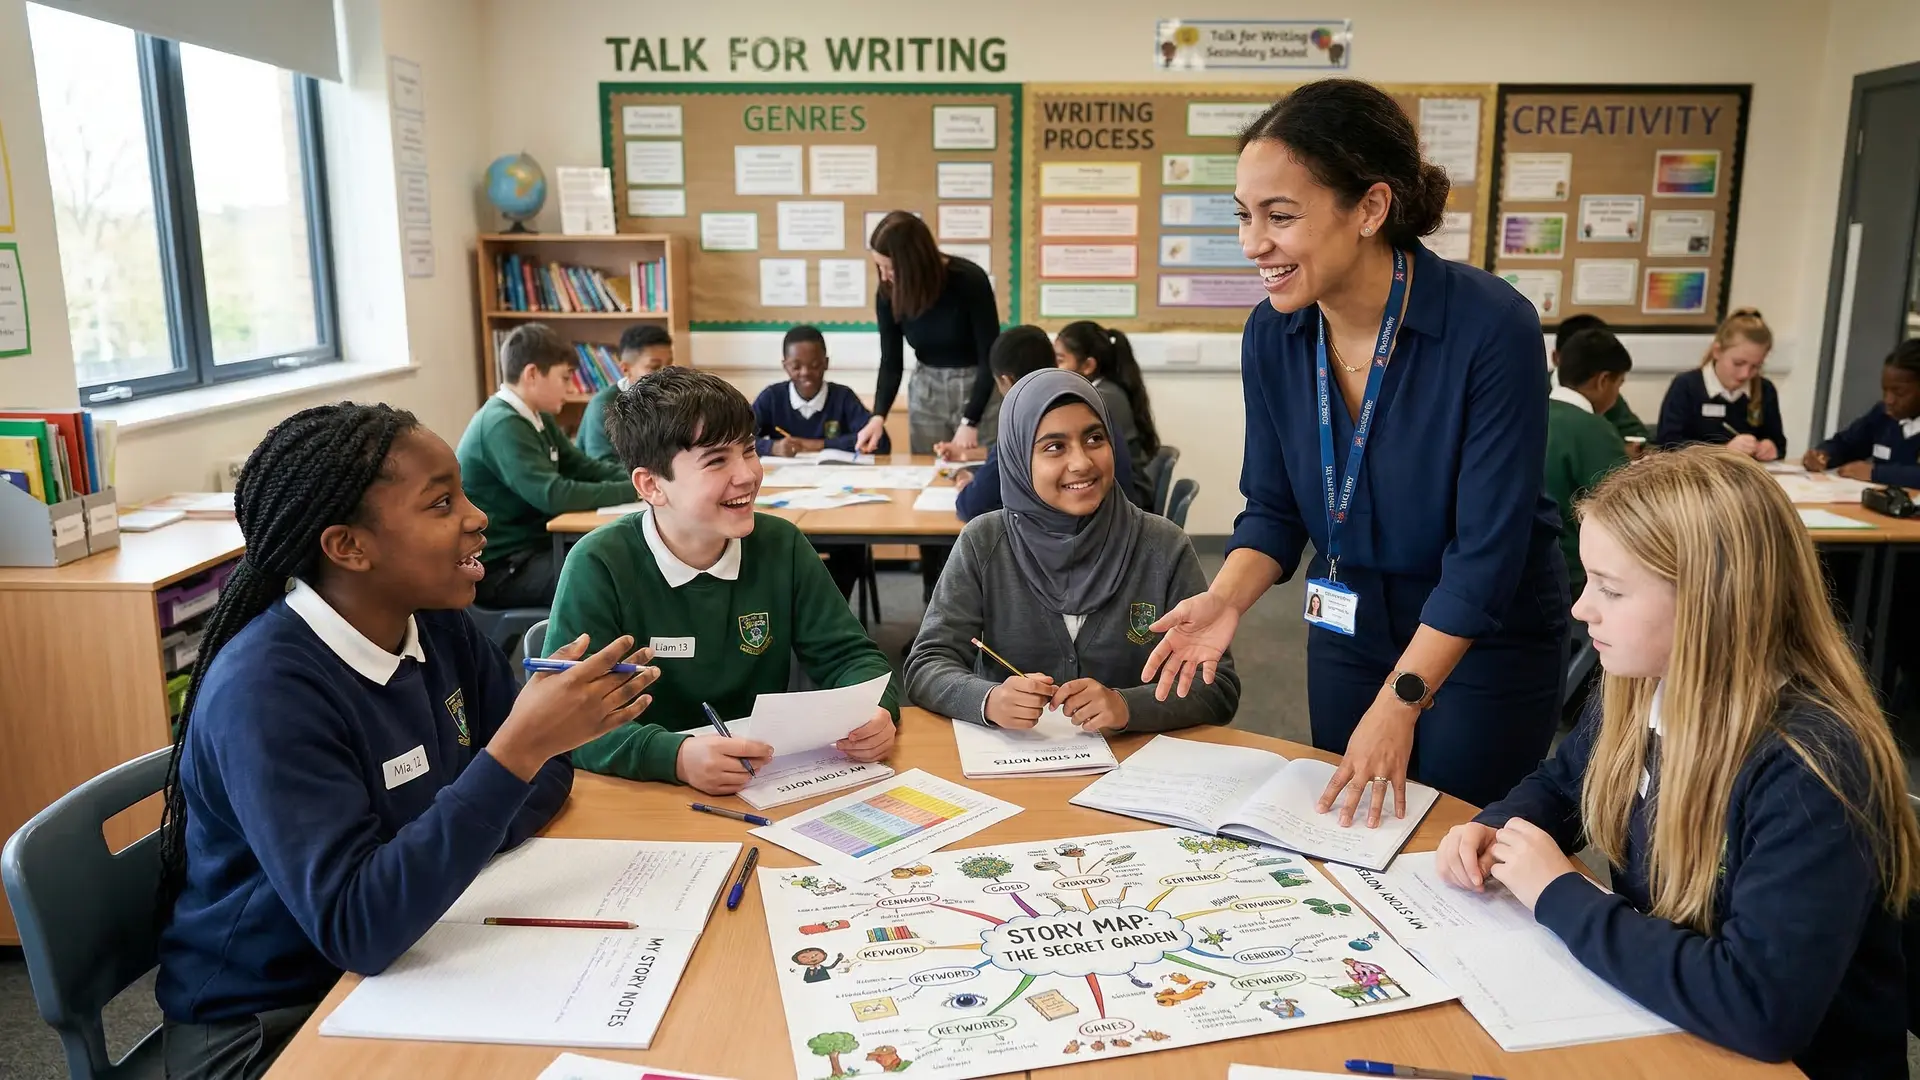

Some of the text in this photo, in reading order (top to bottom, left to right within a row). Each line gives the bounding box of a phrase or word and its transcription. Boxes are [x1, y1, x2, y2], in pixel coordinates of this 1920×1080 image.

[1210, 30, 1308, 45] Talk for Writing
[605, 36, 1007, 73] TALK FOR WRITING
[1207, 47, 1308, 61] Secondary School
[743, 104, 866, 132] GENRES
[1044, 101, 1154, 123] WRITING
[1511, 104, 1722, 136] CREATIVITY
[1044, 128, 1155, 150] PROCESS
[655, 643, 677, 651] Liam
[993, 757, 1031, 765] NOTES
[777, 764, 866, 793] MY STORY NOTES
[1378, 892, 1413, 915] STORY
[1007, 914, 1153, 945] STORY MAP:
[1405, 917, 1428, 930] MY
[863, 945, 918, 959] KEYWORD
[1002, 930, 1178, 962] THE SECRET GARDEN
[607, 937, 665, 1028] MY STORY NOTES
[1238, 972, 1301, 989] KEYWORDS
[937, 1019, 1009, 1035] KEYWORDS
